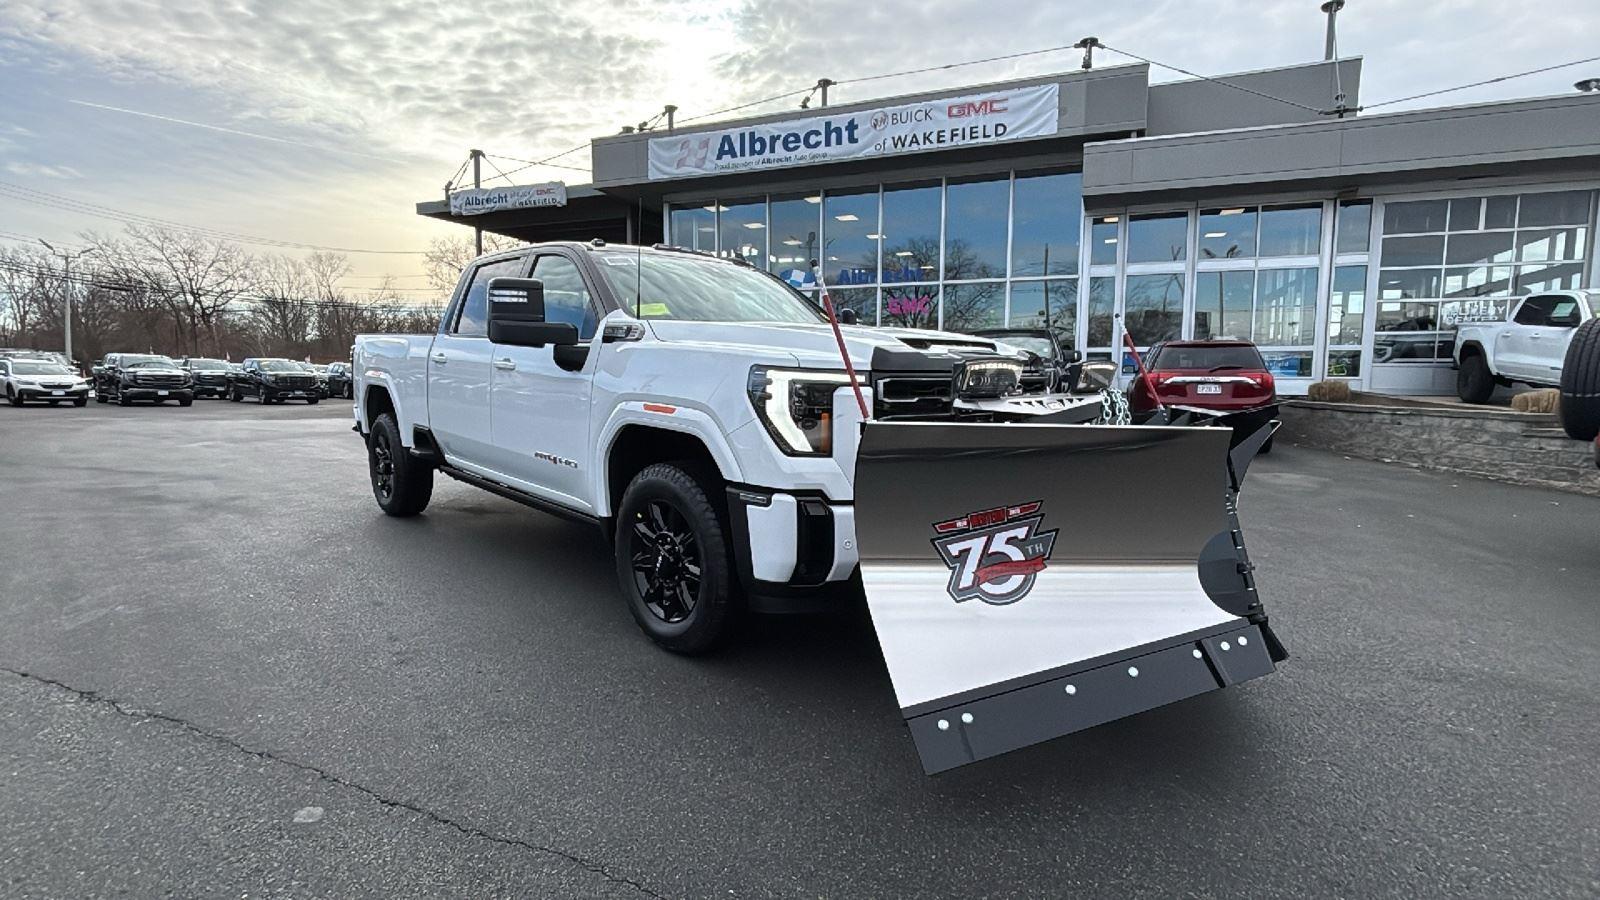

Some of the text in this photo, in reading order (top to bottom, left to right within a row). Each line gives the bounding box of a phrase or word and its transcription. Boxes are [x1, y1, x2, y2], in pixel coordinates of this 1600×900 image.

[891, 98, 1009, 126] BUICK GMC
[715, 118, 859, 160] Albrecht
[874, 123, 1008, 152] of WAKEFIELD
[761, 155, 792, 166] Albrecht
[464, 193, 509, 207] Albrecht
[887, 295, 931, 316] GMC
[946, 526, 1045, 595] 75 TH
